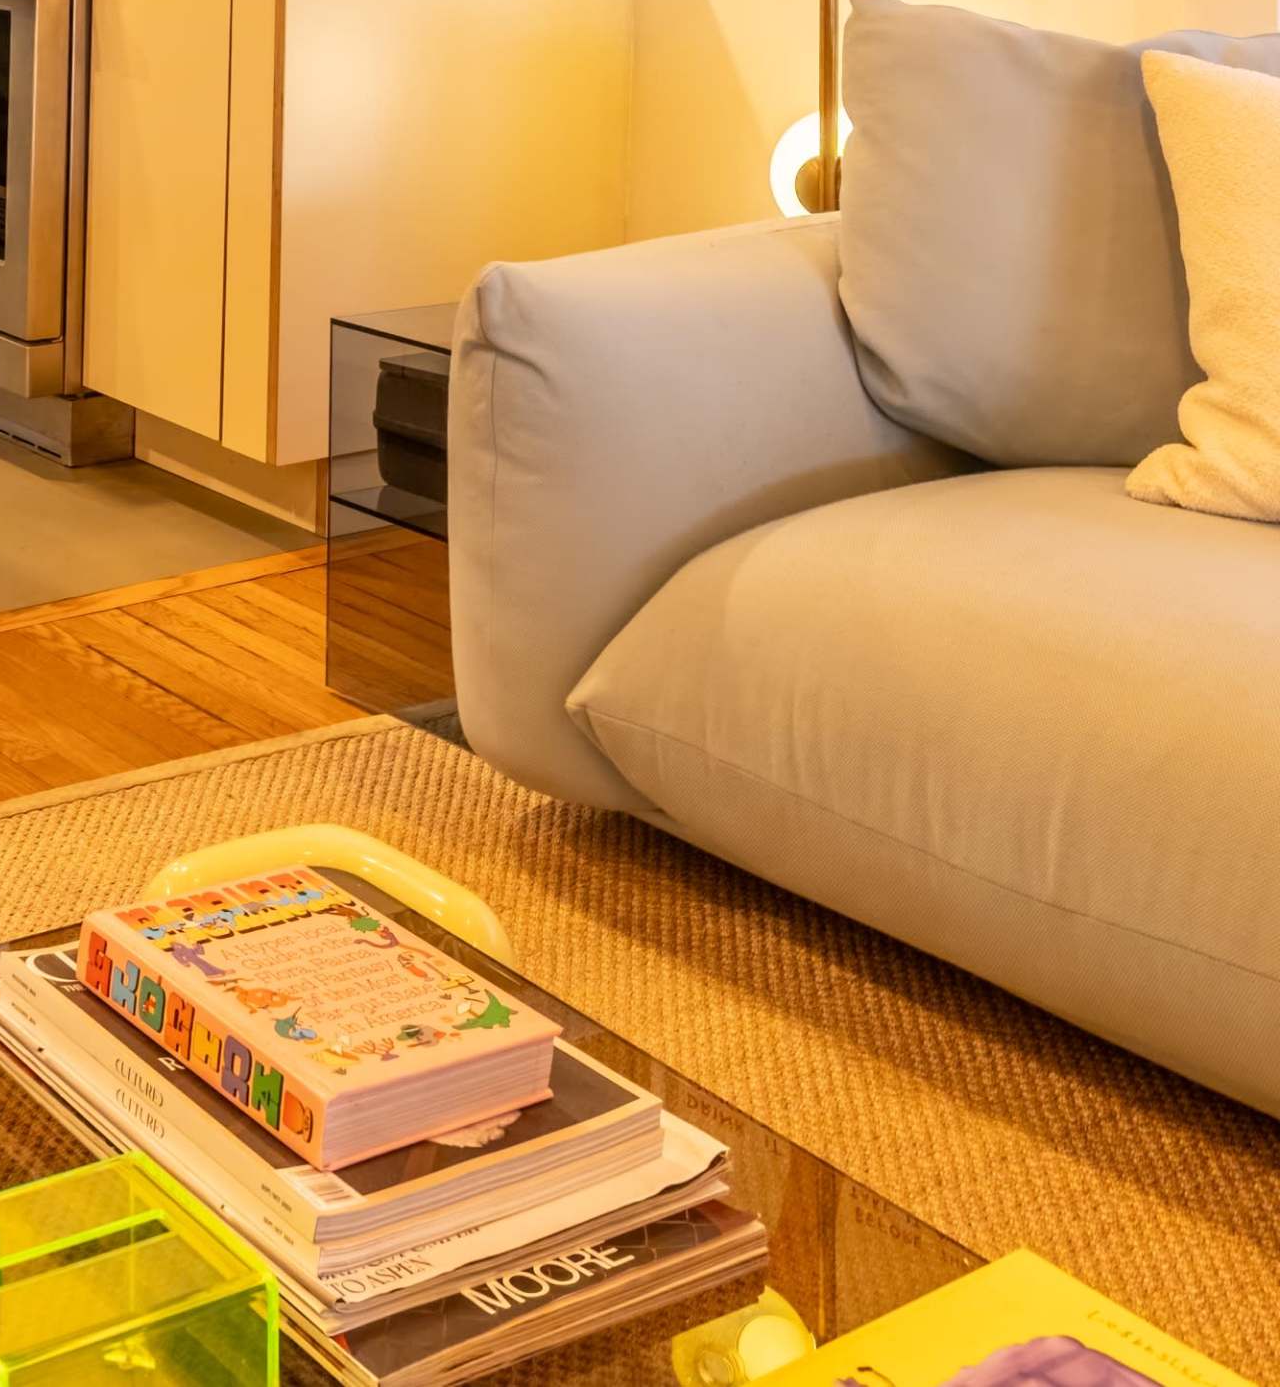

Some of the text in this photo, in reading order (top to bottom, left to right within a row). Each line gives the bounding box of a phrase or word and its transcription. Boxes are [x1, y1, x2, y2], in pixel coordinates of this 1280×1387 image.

[327, 1256, 433, 1298] TO ASPEN
[460, 1245, 635, 1315] MOORE
